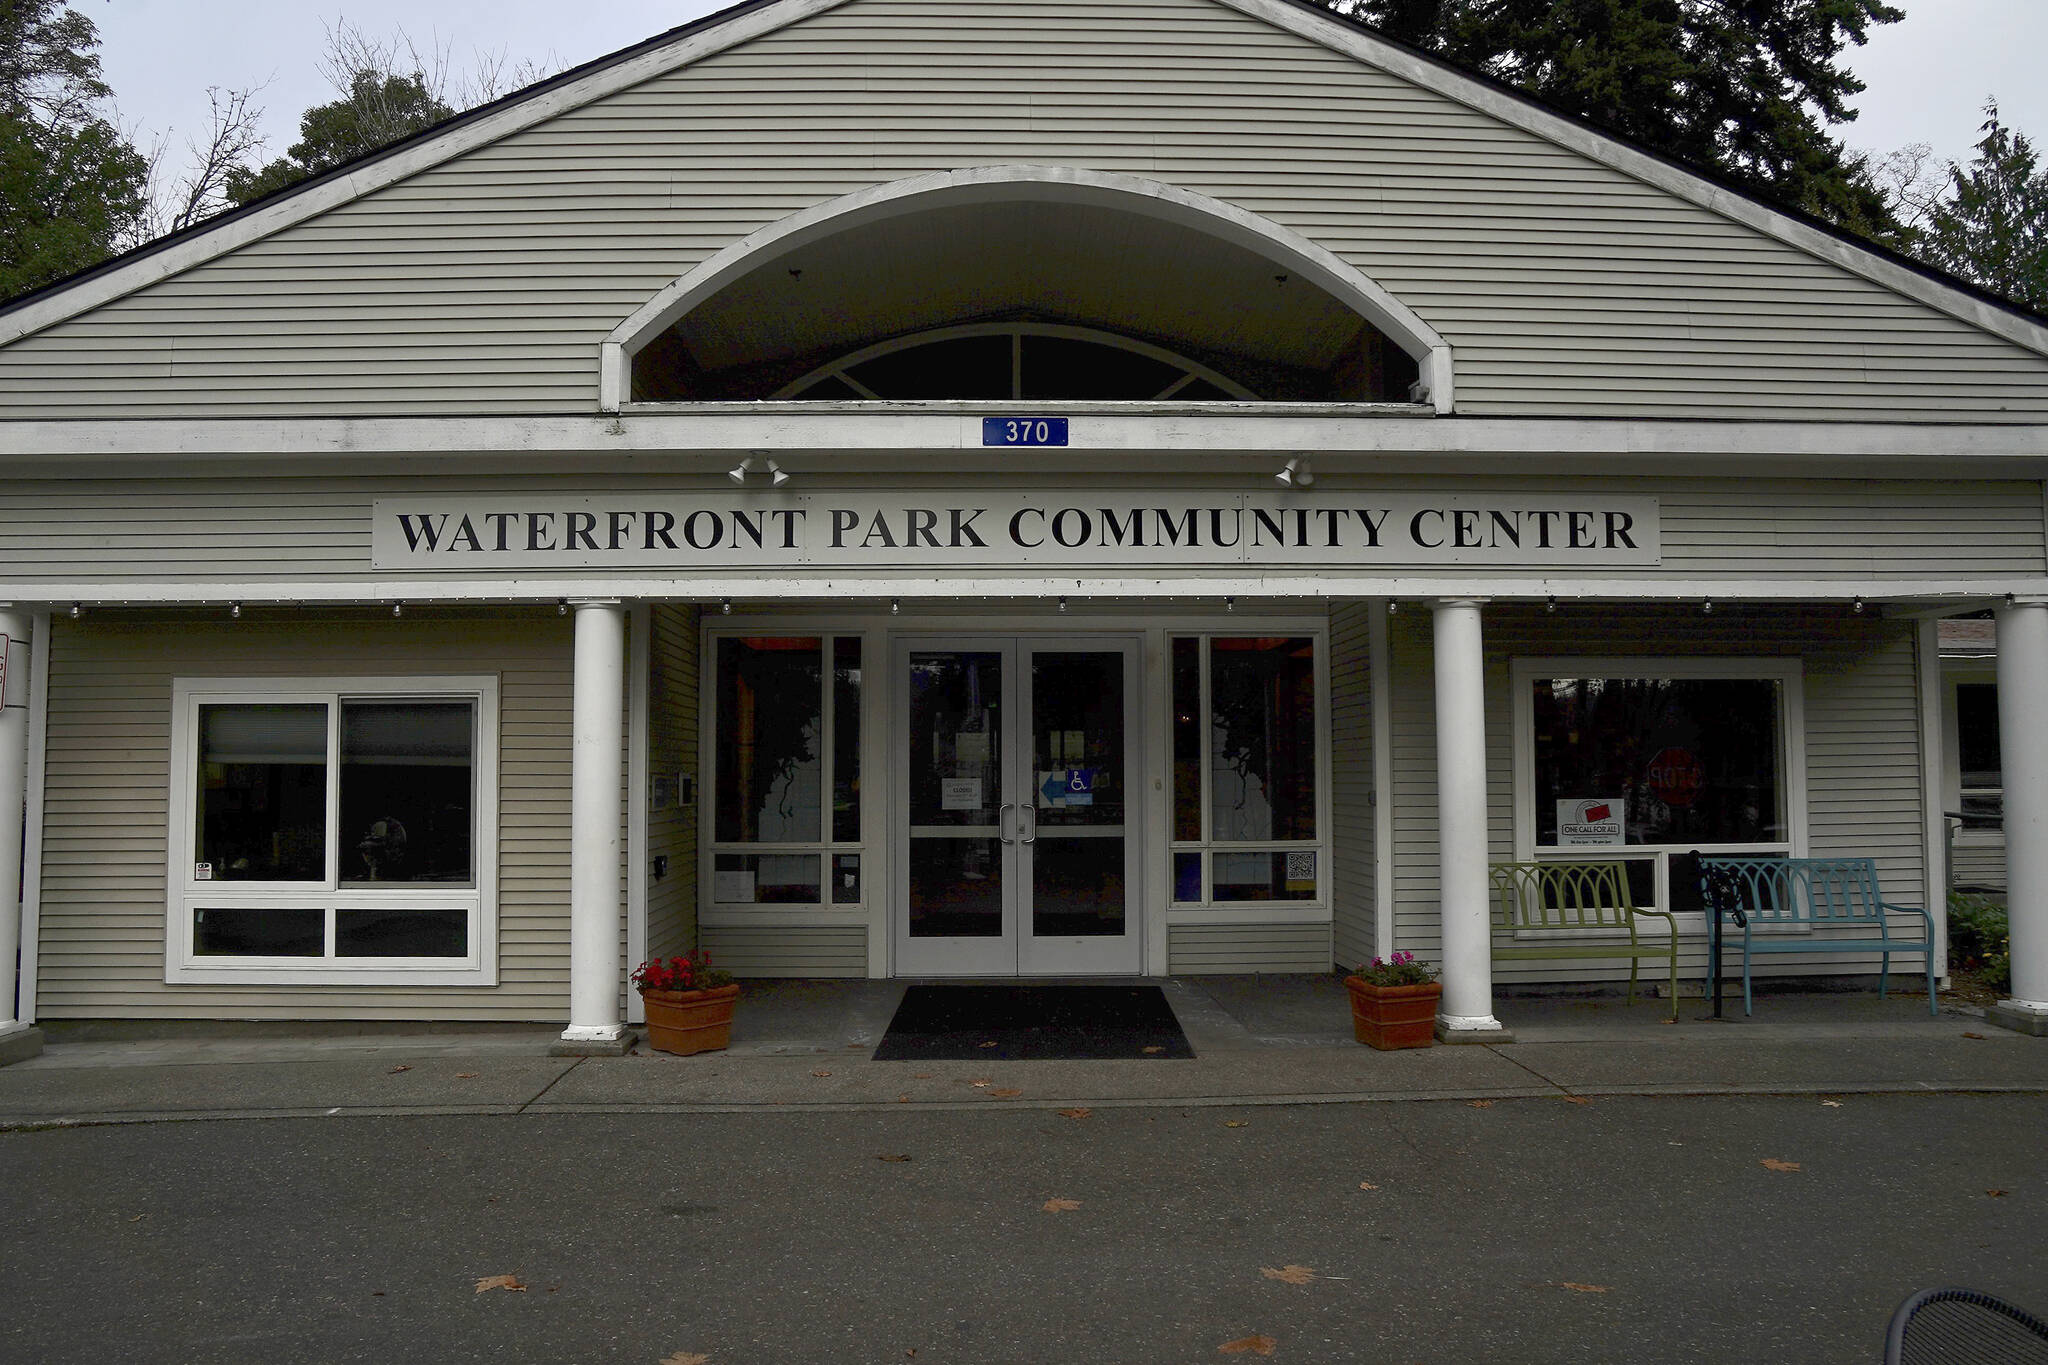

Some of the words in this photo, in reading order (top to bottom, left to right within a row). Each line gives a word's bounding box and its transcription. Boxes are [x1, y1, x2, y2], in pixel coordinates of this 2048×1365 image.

[1006, 421, 1049, 443] 370
[396, 509, 807, 552] WATERFRONT
[827, 508, 989, 548] PARK
[1010, 507, 1391, 549] COMMUNITY
[1410, 508, 1639, 549] CENTER
[1564, 825, 1579, 833] ONE
[1579, 825, 1592, 833] CALL
[1593, 825, 1606, 833] FOR
[1607, 824, 1617, 833] ALL
